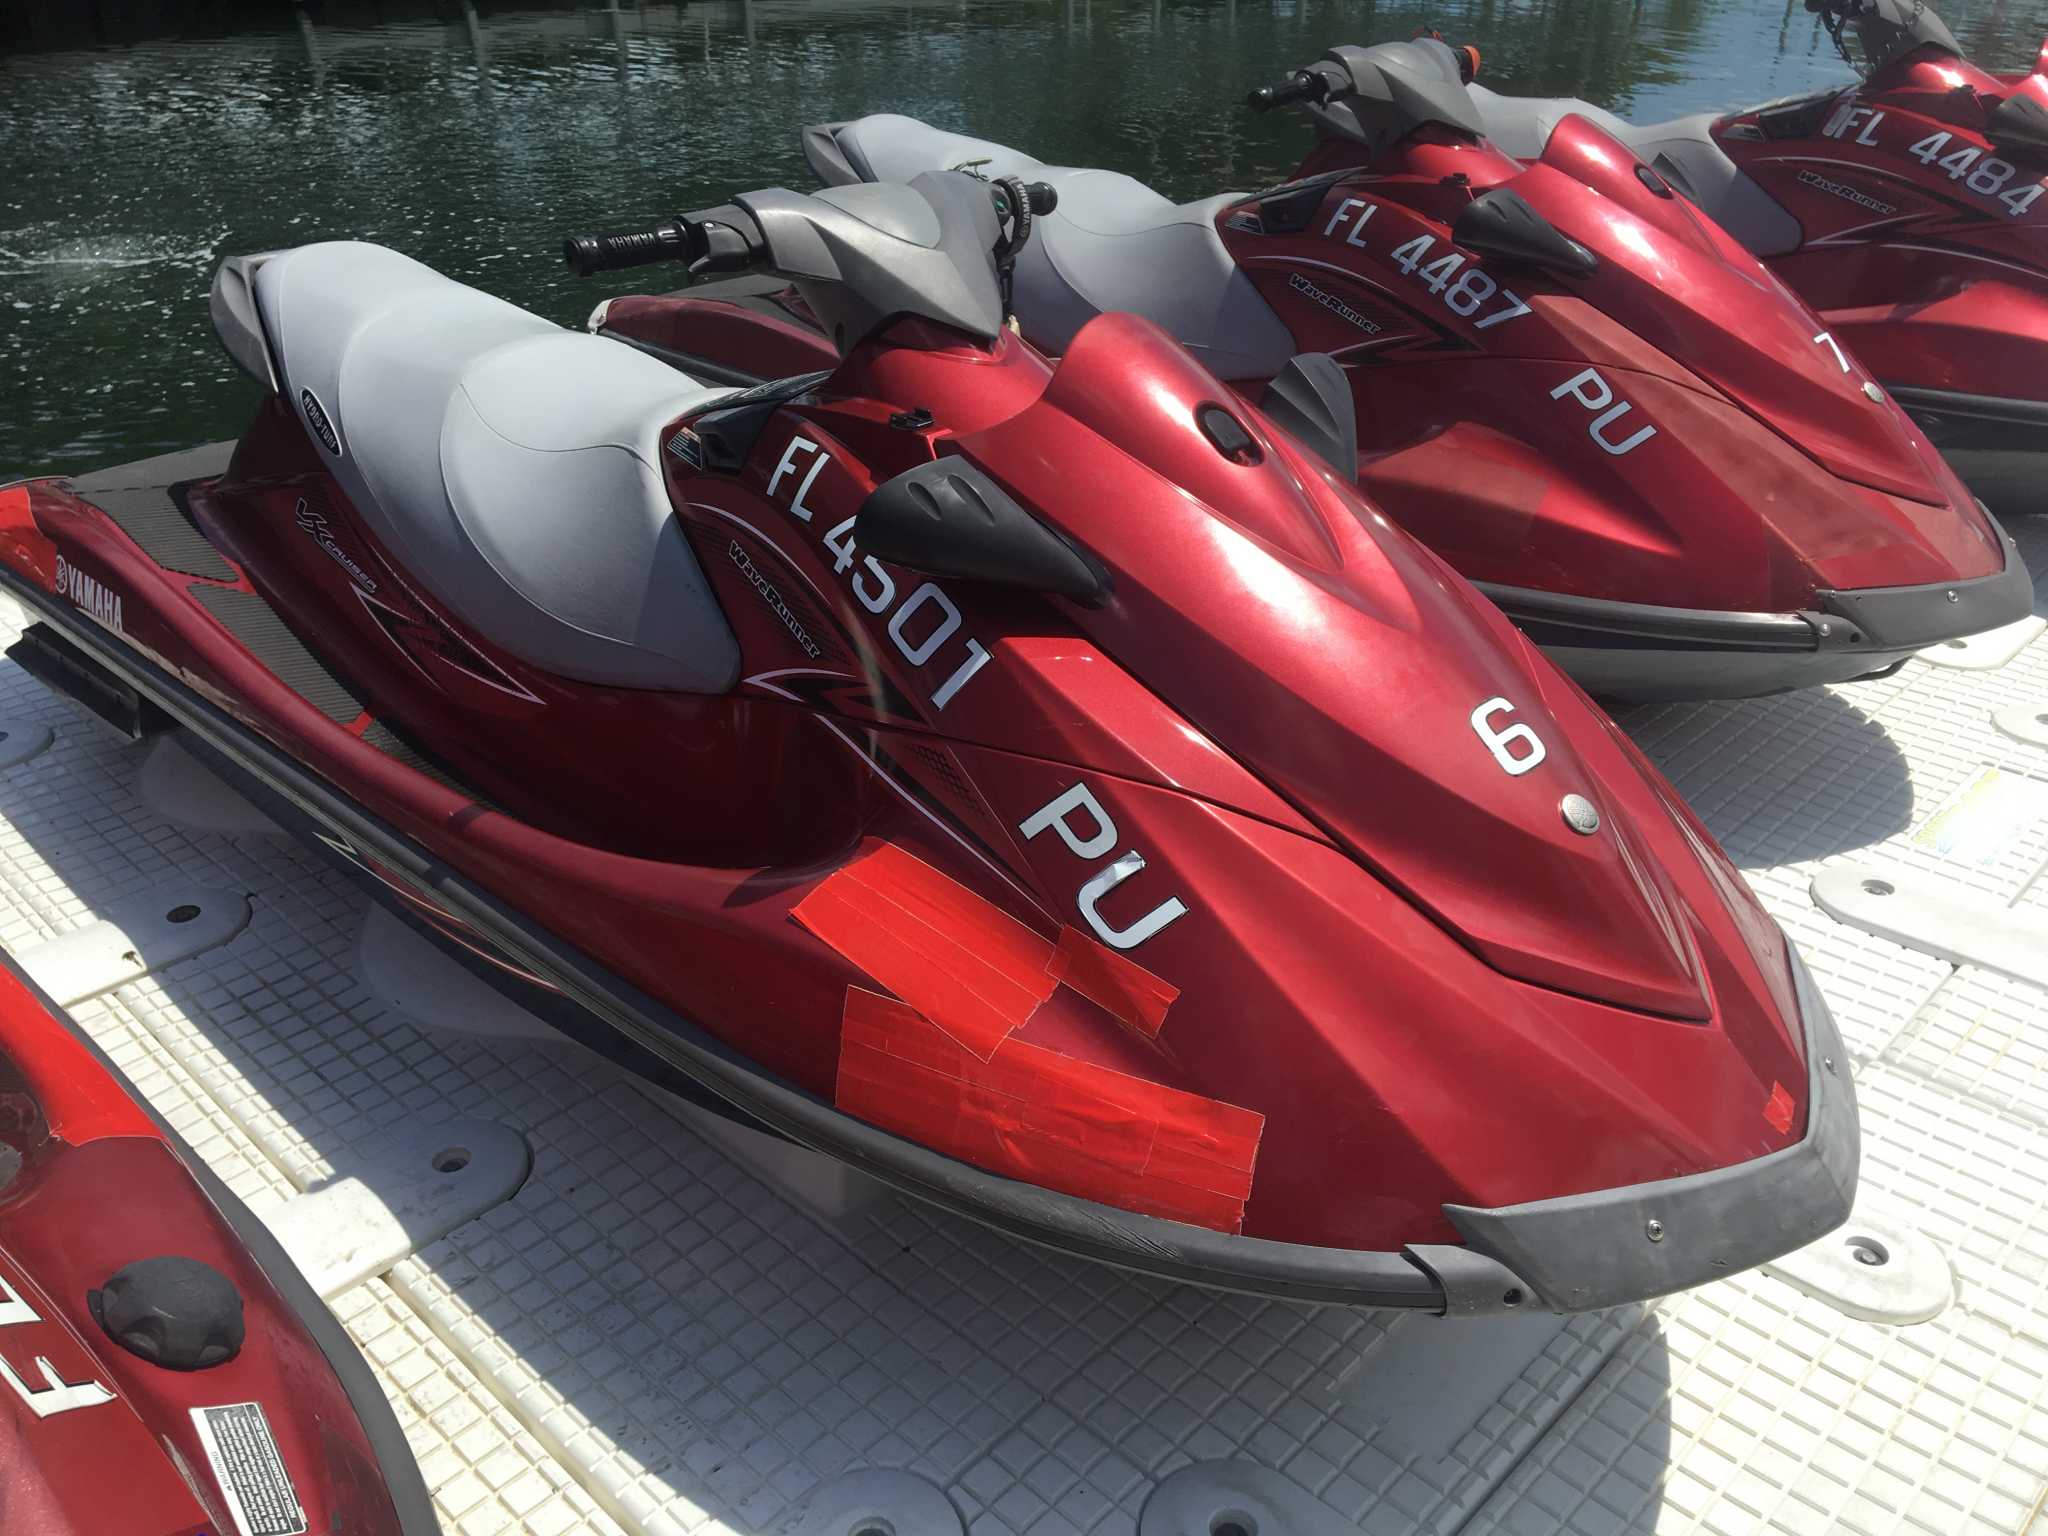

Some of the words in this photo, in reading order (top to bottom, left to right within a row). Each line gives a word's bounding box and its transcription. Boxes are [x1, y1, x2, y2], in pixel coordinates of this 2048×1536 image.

[1797, 168, 1897, 215] WaveRunner
[1834, 107, 1886, 147] FL
[1908, 130, 2047, 217] 4484
[1016, 182, 1031, 226] YAMAHA
[1289, 273, 1383, 336] WaveRunner
[1323, 198, 1378, 249] FL
[1390, 234, 1534, 329] 4487
[1813, 332, 1850, 373] 7
[304, 394, 337, 450] HYDRO-TURF
[1549, 367, 1657, 456] PU
[766, 435, 831, 523] FL
[67, 563, 123, 633] YAMAHA
[728, 539, 821, 659] WaveRunner
[1471, 695, 1546, 777] 6
[1018, 781, 1190, 949] PU
